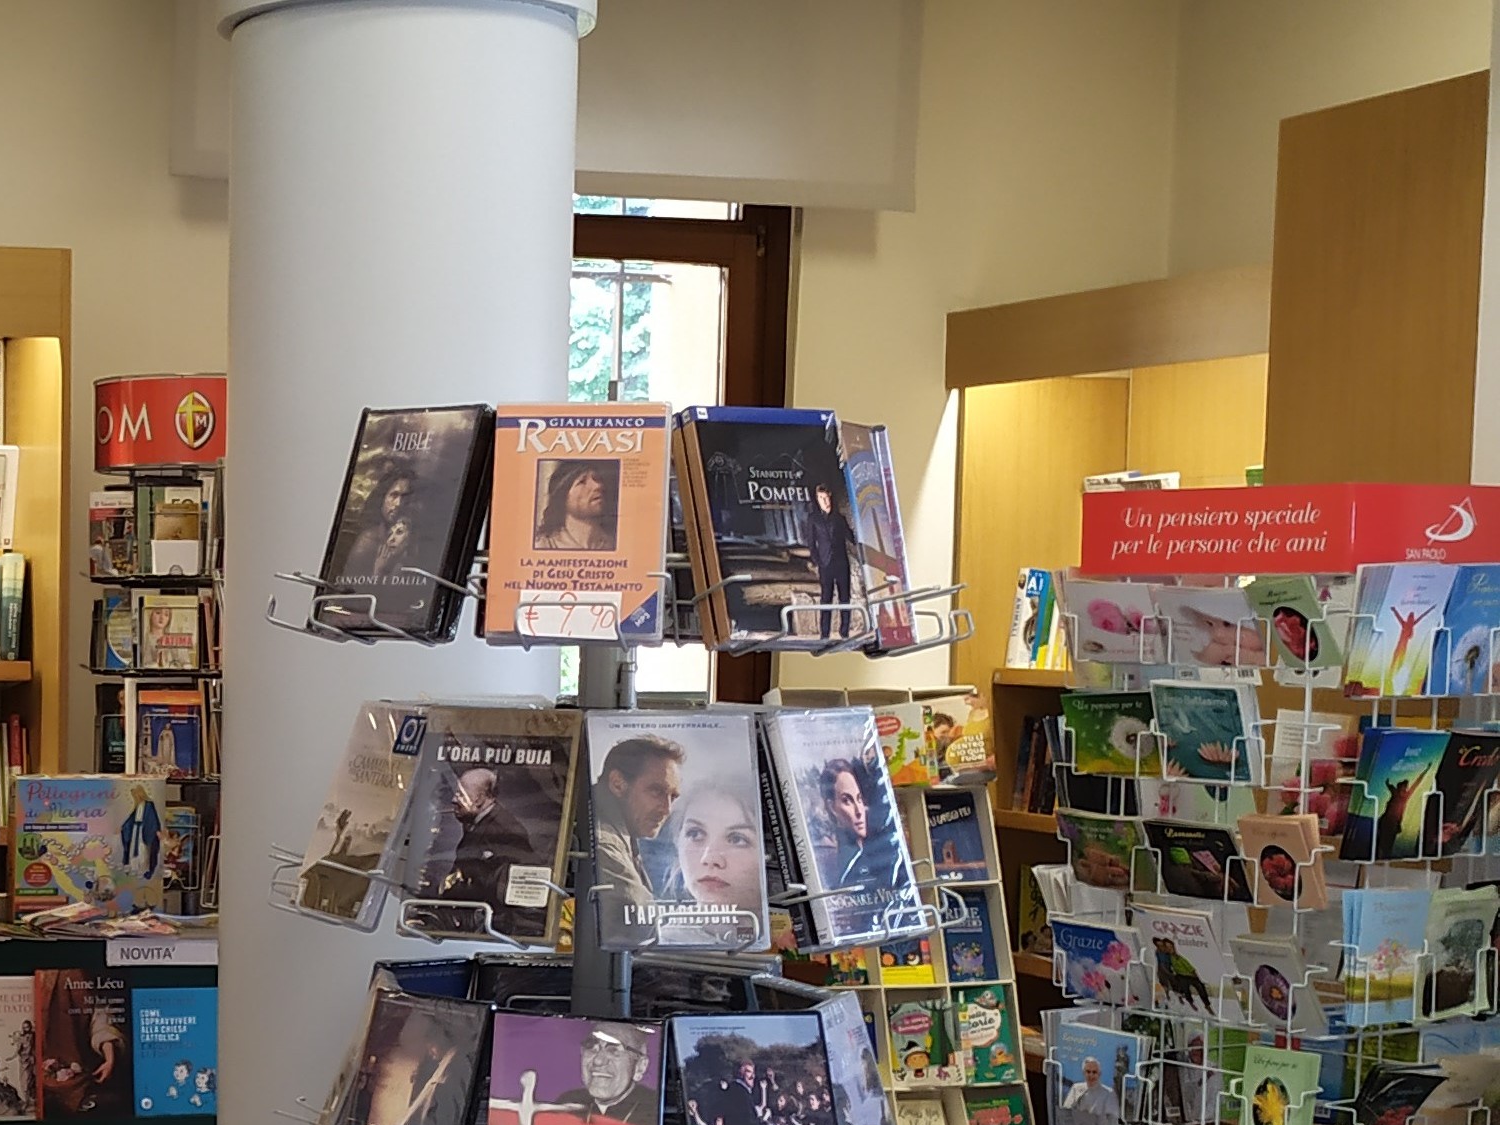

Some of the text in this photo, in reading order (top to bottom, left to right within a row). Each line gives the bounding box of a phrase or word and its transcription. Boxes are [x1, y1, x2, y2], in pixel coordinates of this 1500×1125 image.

[549, 418, 645, 428] GIANFRANCO
[393, 431, 434, 452] BIBLE
[517, 418, 645, 454] RAVASI
[749, 467, 794, 479] STANOTTE
[748, 481, 810, 501] POMPEI
[1123, 502, 1321, 533] Un pensiero speciale
[1111, 531, 1327, 560] per le persone che ami
[1405, 548, 1446, 560] SAN PAOLO
[520, 559, 628, 568] LA MANIFESTAZIONE
[532, 569, 615, 579] DI CRISTO
[335, 575, 427, 587] SANSONE E DALILA
[504, 580, 642, 592] NEL NUOVO TESTAMENTO
[437, 744, 551, 765] L'ORA PIÙ BUIA
[26, 781, 120, 803] Pellegrini
[49, 802, 107, 820] Maria
[623, 903, 739, 925] L'APPARIZIONE
[1152, 920, 1204, 937] GRAZIE
[1060, 928, 1104, 950] Grazie
[120, 947, 176, 960] NOVITA'
[64, 976, 124, 989] Anne Lécu
[140, 1016, 197, 1026] SOPRAVVIVERE
[140, 1025, 158, 1033] ALLA
[140, 1033, 180, 1042] CATTOLICA
